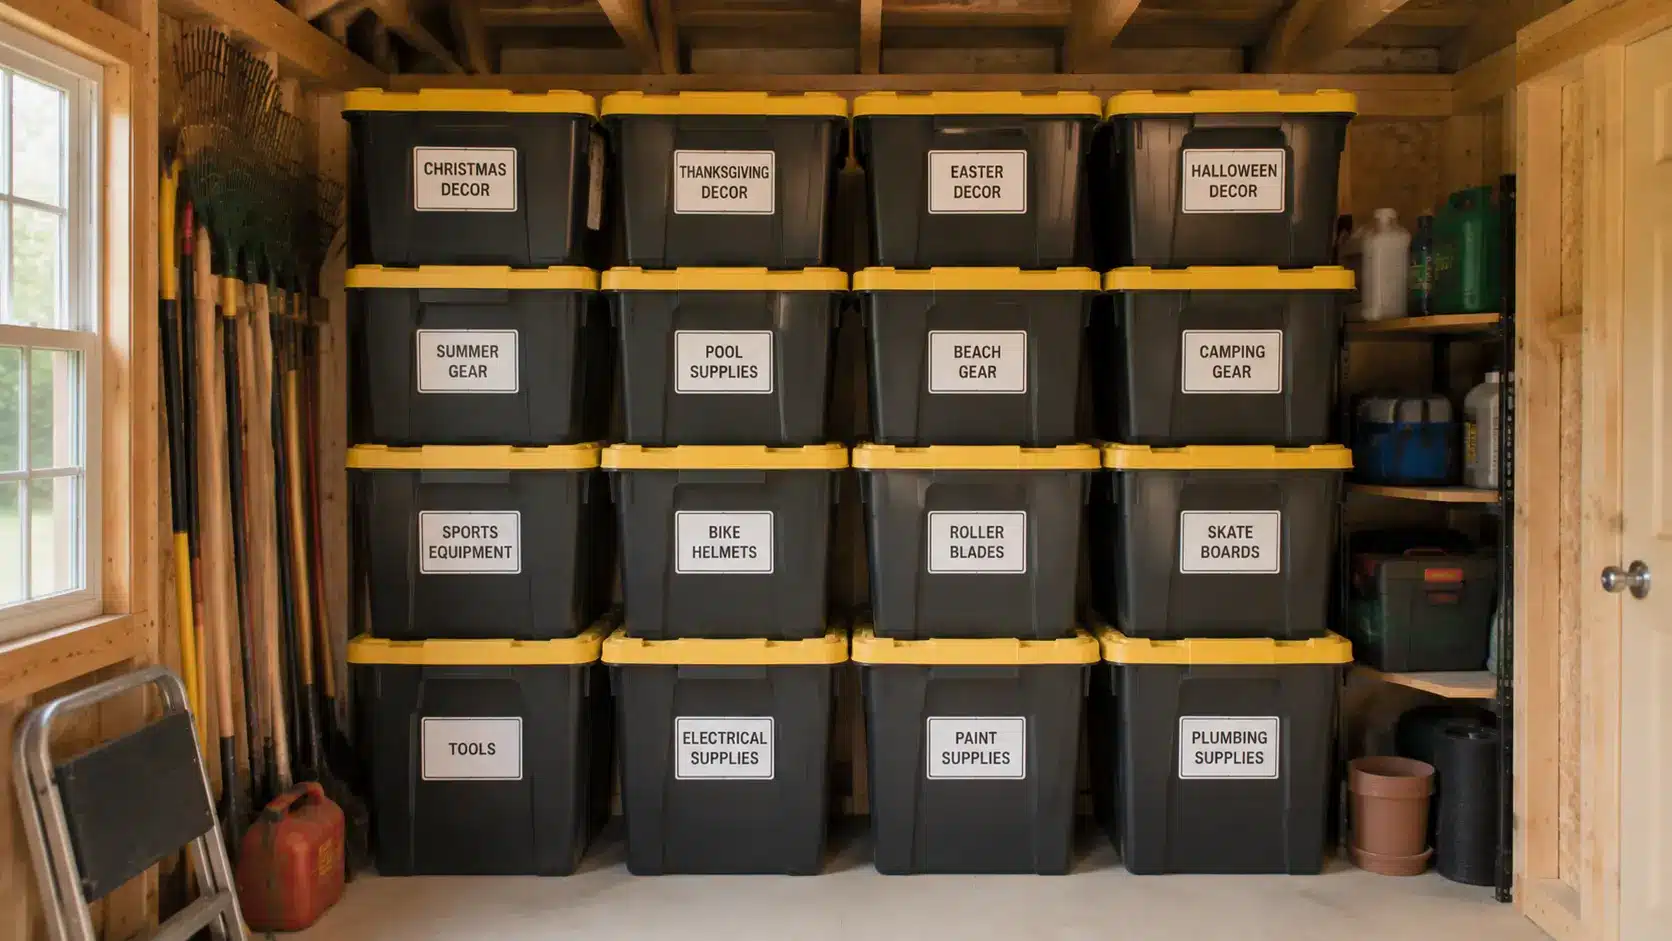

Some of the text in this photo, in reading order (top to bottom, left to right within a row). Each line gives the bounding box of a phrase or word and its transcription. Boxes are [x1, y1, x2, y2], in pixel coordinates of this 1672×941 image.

[424, 162, 506, 176] CHRISTMAS
[679, 165, 769, 179] THANKSGIVING
[951, 165, 1003, 178] EASTER
[1192, 164, 1277, 177] HALLOWEEN
[442, 183, 489, 196] DECOR
[702, 186, 747, 199] DECOR
[954, 185, 1001, 198] DECOR
[1210, 184, 1257, 198] DECOR
[437, 345, 498, 358] SUMMER
[706, 345, 742, 358] POOL
[954, 346, 1000, 358] BEACH
[1200, 345, 1265, 358] CAMPING
[449, 365, 487, 377] GEAR
[691, 365, 757, 378] SUPPLIES
[959, 365, 996, 378] GEAR
[1213, 365, 1251, 378] GEAR
[443, 526, 498, 539] SPORTS
[710, 526, 740, 538] BIKE
[951, 526, 1004, 538] ROLLER
[1208, 526, 1253, 538] SKATE
[429, 546, 512, 559] EQUIPMENT
[693, 546, 757, 558] HELMETS
[951, 546, 1004, 558] BLADES
[1201, 546, 1259, 558] BOARDS
[684, 732, 767, 744] ELECTRICAL
[956, 732, 997, 744] PAINT
[1192, 731, 1267, 744] PLUMBING
[448, 743, 496, 755] TOOLS
[691, 751, 758, 764] SUPPLIES
[942, 752, 1010, 764] SUPPLIES
[1195, 751, 1264, 764] SUPPLIES
